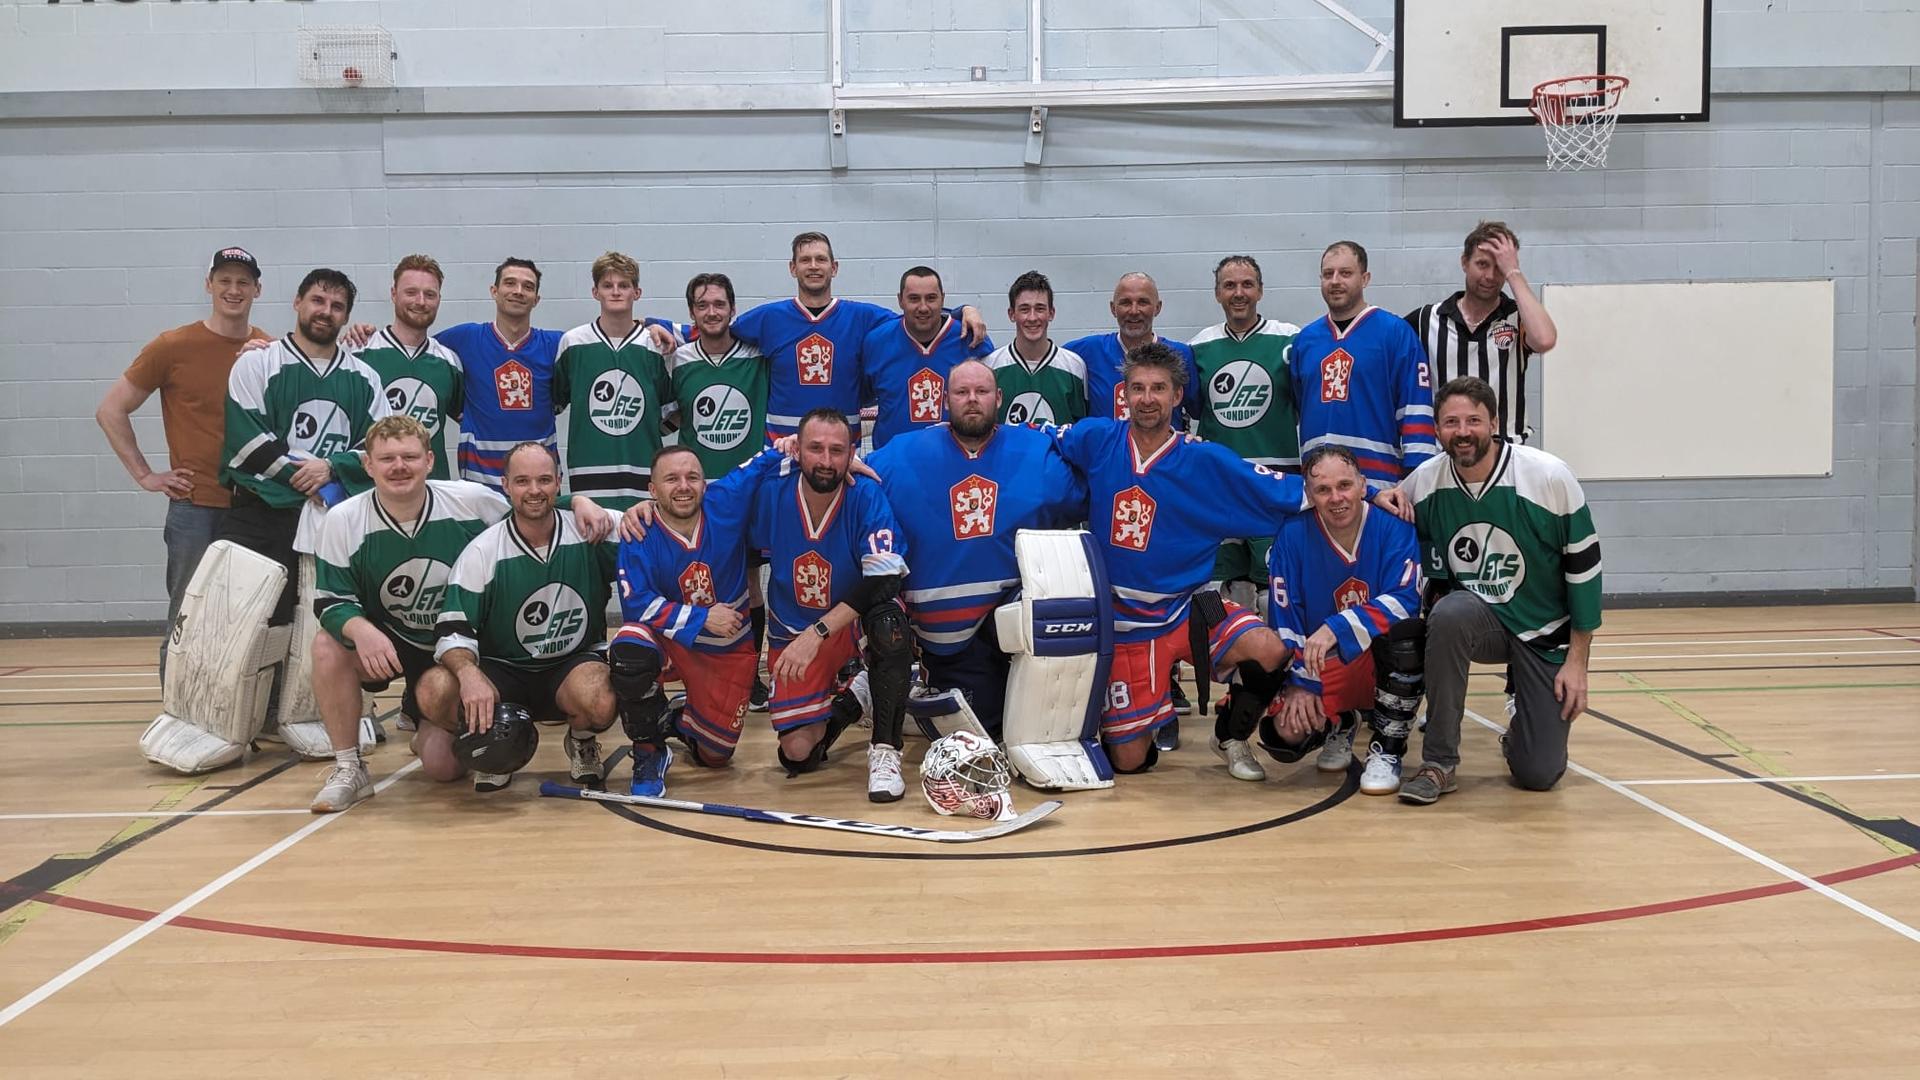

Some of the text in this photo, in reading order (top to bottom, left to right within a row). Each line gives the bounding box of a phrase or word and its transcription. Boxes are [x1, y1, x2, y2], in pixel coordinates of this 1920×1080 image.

[703, 432, 740, 444] LONDON
[1045, 622, 1093, 633] CCM
[791, 815, 936, 834] CCM
